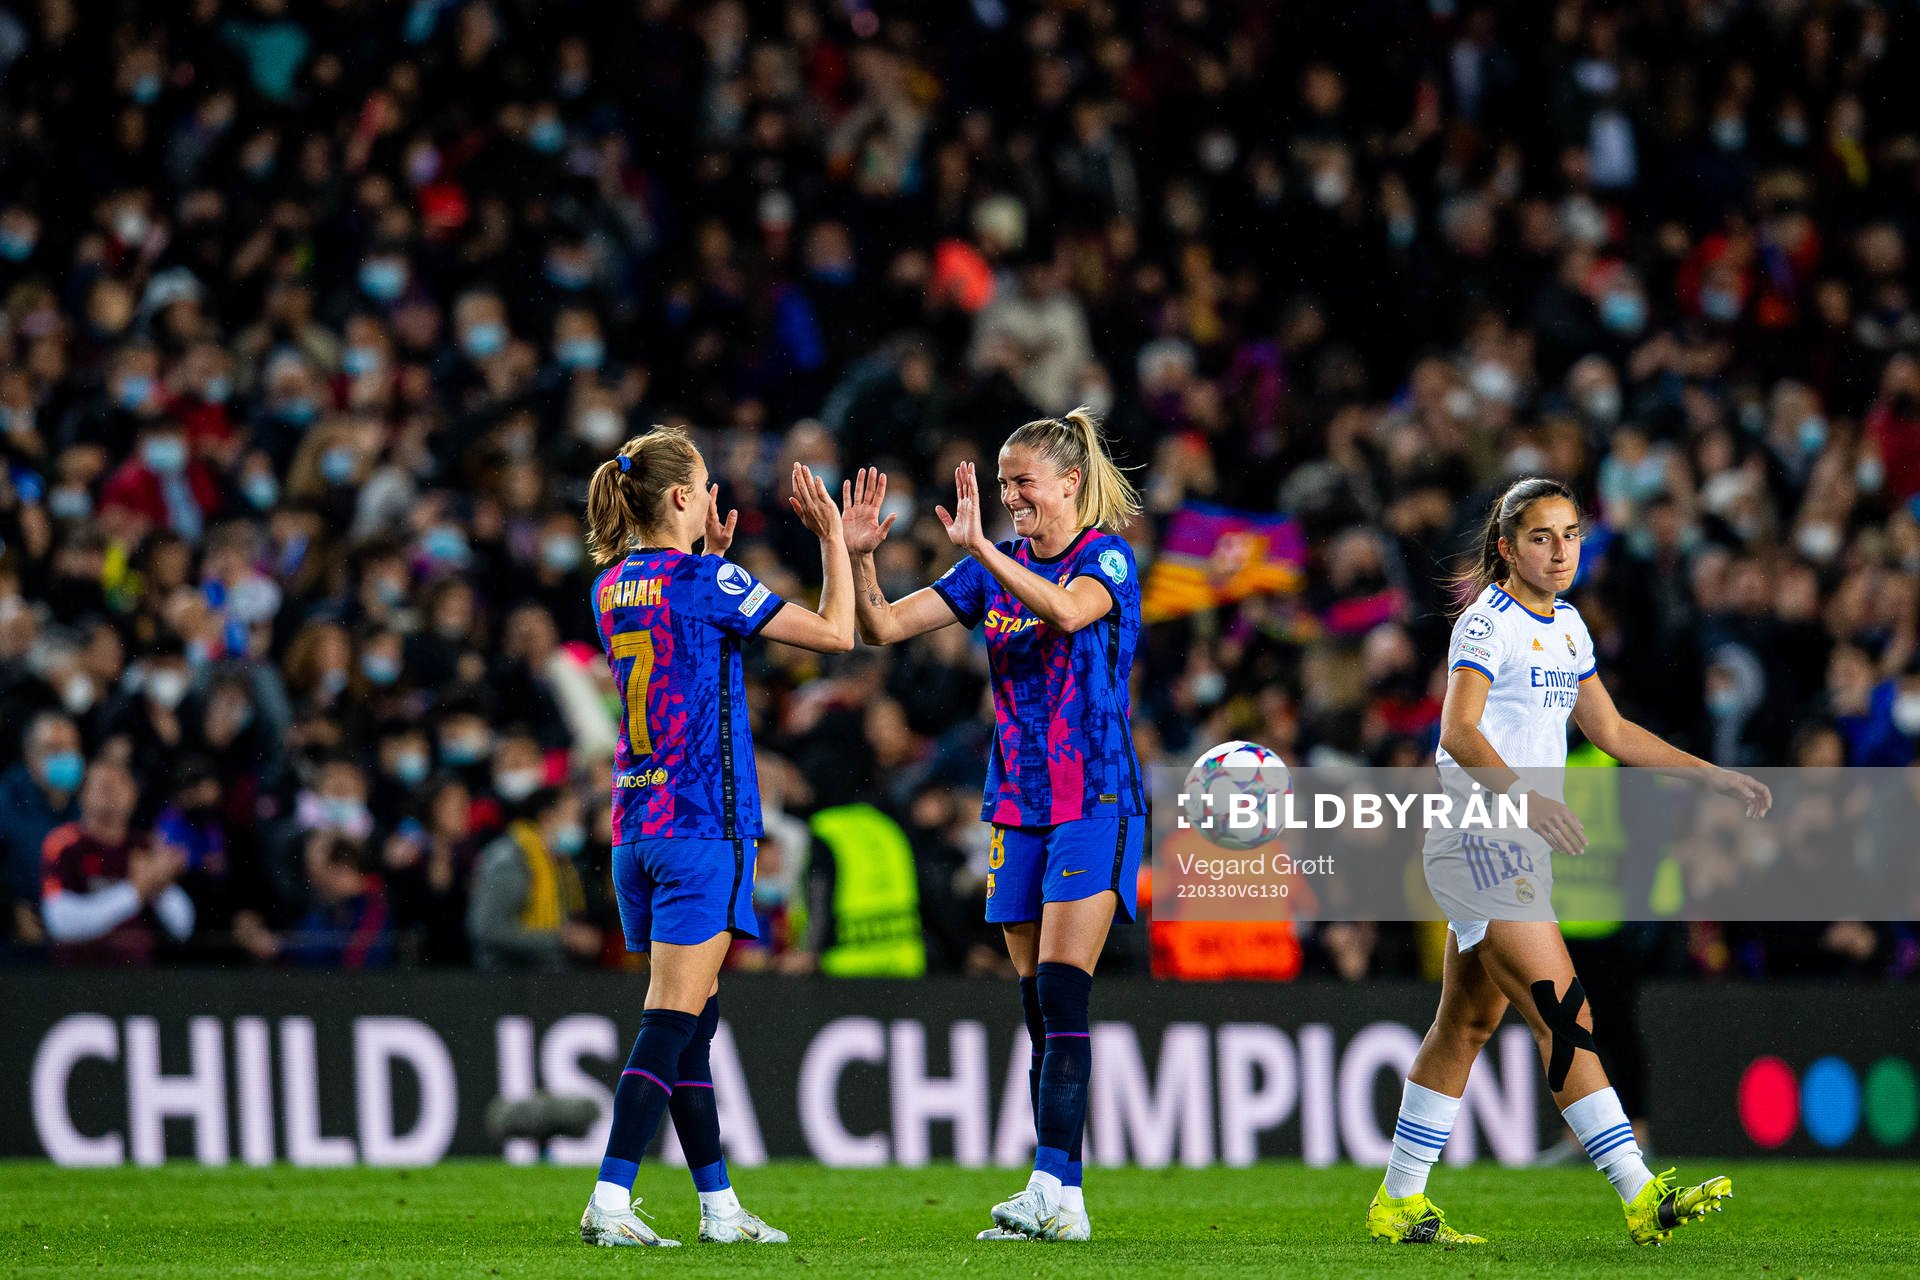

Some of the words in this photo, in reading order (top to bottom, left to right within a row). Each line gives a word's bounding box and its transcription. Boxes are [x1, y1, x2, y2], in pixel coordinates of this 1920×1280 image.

[600, 578, 663, 613] GRAHAM
[611, 629, 654, 755] 7
[616, 769, 652, 788] unicef
[31, 1014, 458, 1167] CHILD
[495, 1013, 619, 1167] IS
